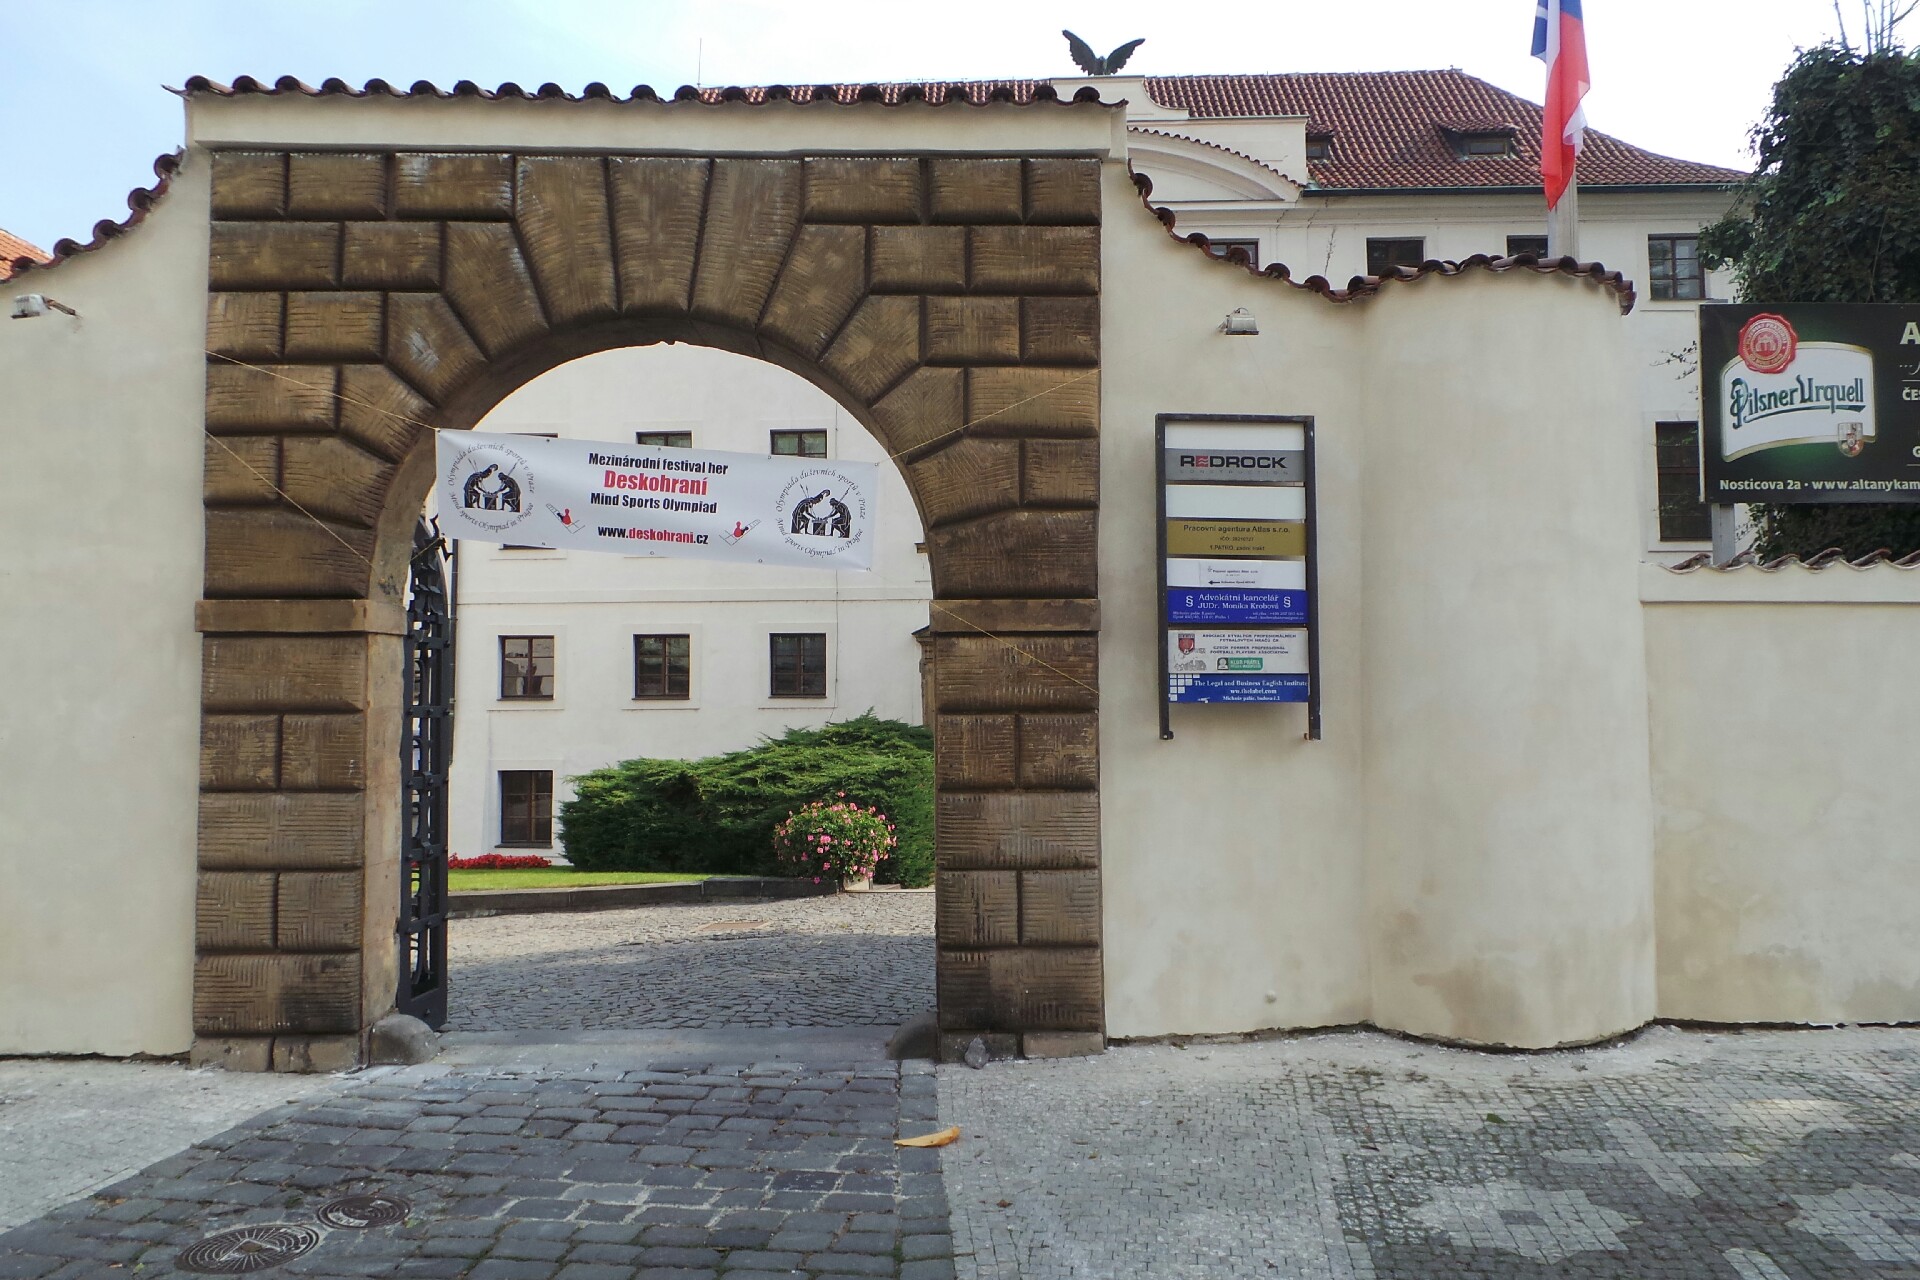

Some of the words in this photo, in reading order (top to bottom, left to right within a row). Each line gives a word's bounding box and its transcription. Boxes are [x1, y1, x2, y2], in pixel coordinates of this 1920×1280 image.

[1730, 377, 1798, 430] Pilsner
[1796, 374, 1864, 414] Urquell
[588, 452, 660, 471] Mezinárodní
[662, 458, 706, 474] festival
[707, 461, 728, 475] her
[1180, 455, 1288, 469] REDROCK
[604, 470, 708, 496] Deskohraní
[1719, 478, 1784, 490] Nosticova
[1786, 479, 1802, 490] 2a
[591, 492, 620, 506] Mind
[622, 494, 660, 509] Sports
[663, 498, 718, 514] Olympiad
[597, 526, 709, 545] www.deskohrani.cz
[1183, 524, 1216, 532] Pracovní
[1218, 525, 1250, 534] agentura
[1252, 525, 1271, 533] Atlas
[1272, 526, 1291, 534] s.r.o.
[1198, 593, 1241, 602] Advokátní
[1243, 593, 1279, 602] kancelář
[1198, 602, 1220, 610] JUDr.
[1222, 602, 1249, 610] Monika
[1250, 602, 1279, 610] Krobová
